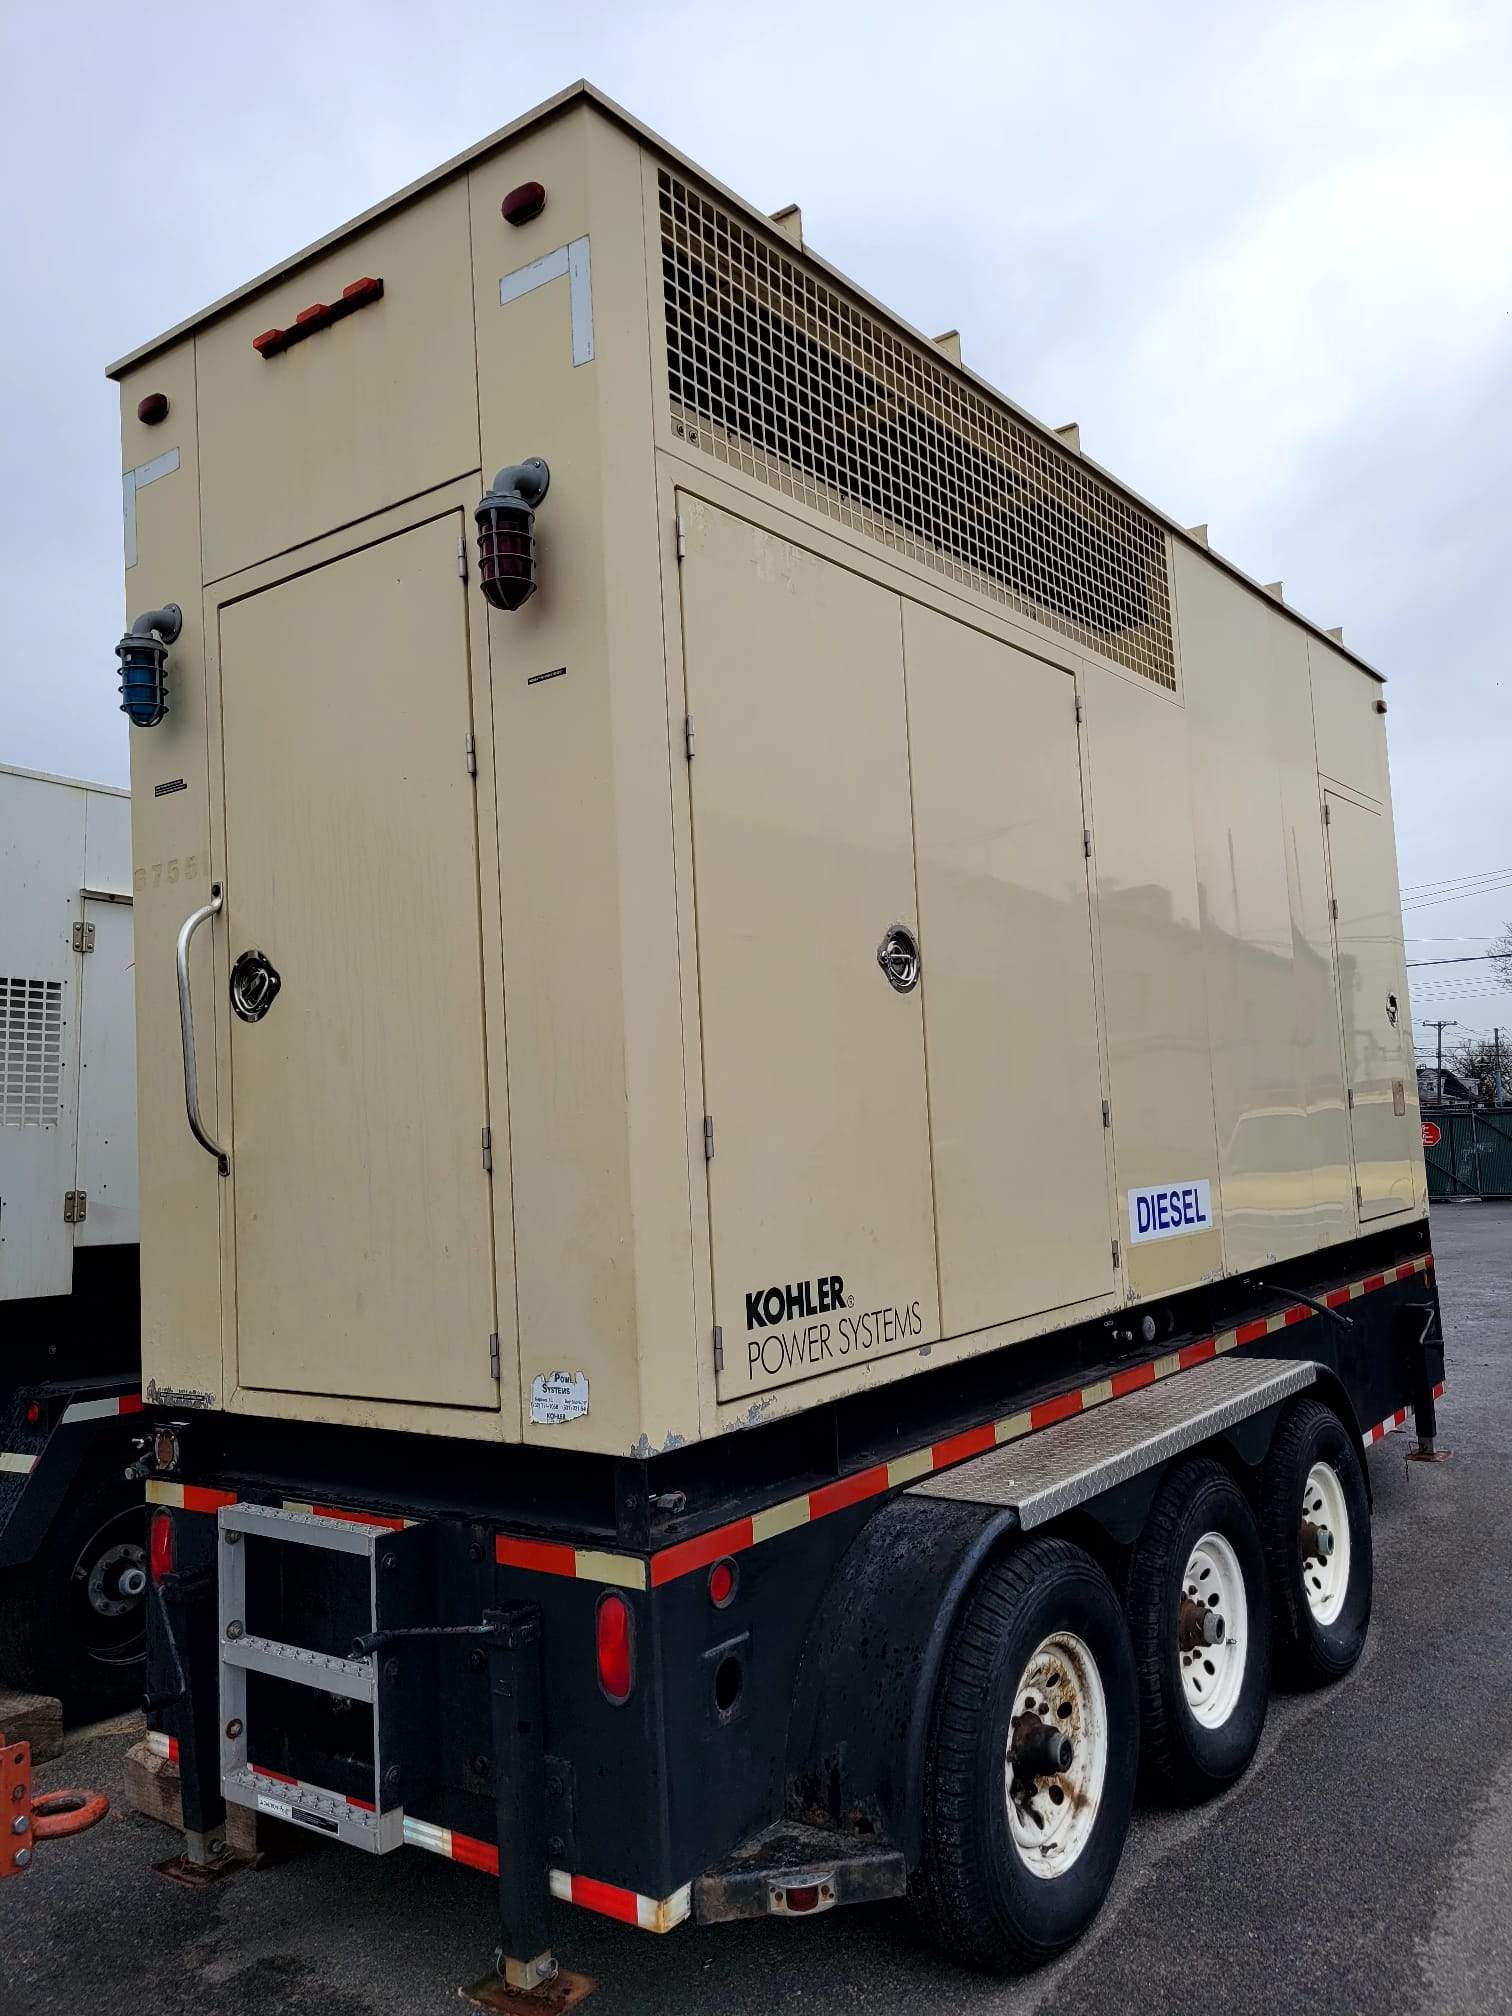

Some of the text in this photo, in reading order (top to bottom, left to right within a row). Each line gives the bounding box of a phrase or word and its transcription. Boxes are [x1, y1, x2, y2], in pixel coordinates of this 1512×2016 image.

[1136, 1188, 1207, 1234] DIESEL
[748, 1301, 922, 1380] POWER SYSTEMS
